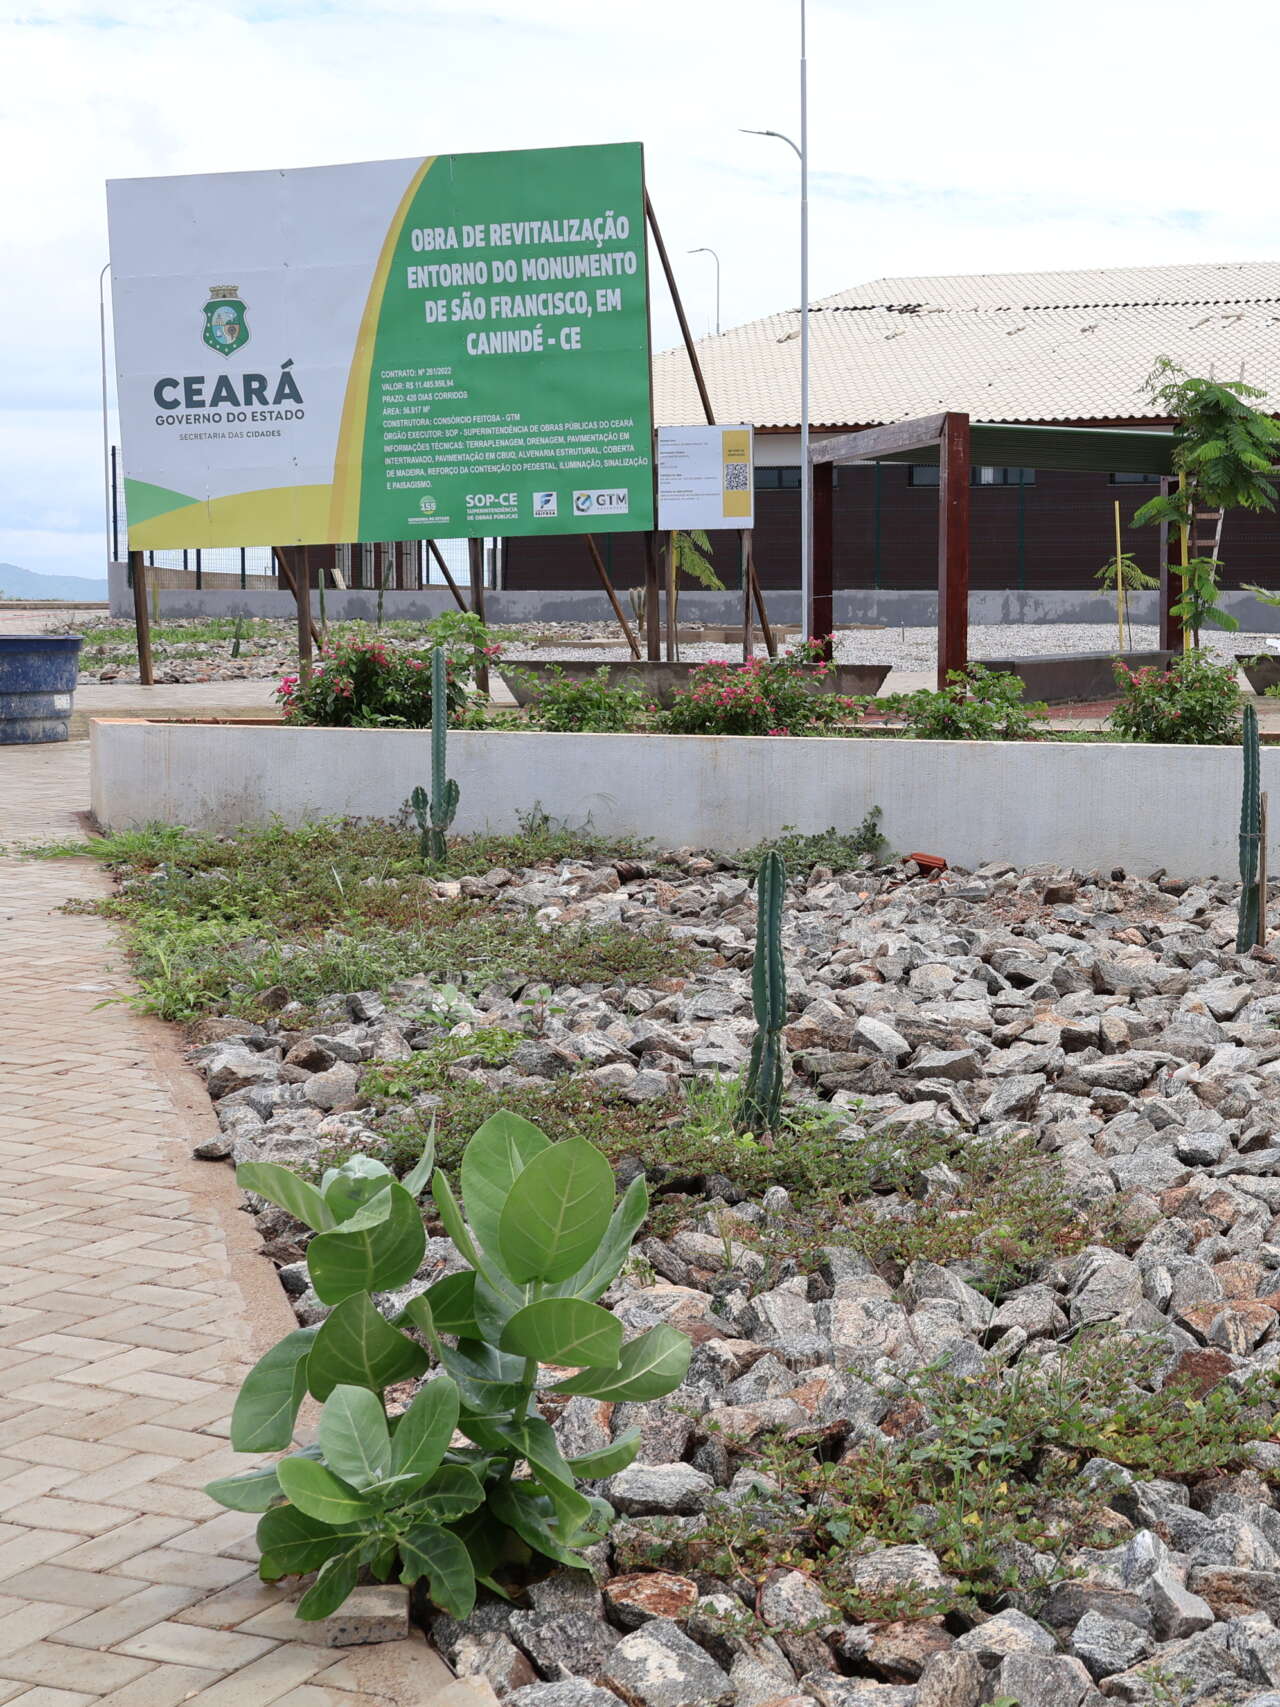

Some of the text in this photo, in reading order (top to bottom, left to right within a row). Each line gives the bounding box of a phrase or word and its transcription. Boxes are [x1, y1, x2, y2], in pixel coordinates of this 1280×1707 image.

[411, 210, 629, 252] OBRA DE REVITALIZAÇÃO
[407, 251, 637, 289] ENTORNO DO MONUMENTO
[425, 288, 622, 323] DE SÃO FRANCISCO, EM
[466, 324, 581, 355] CANINDÉ - CE
[154, 358, 304, 410] CEARÁ
[382, 382, 404, 391] VALOR:
[382, 394, 405, 403] PRAZO:
[418, 392, 433, 401] DIAS
[434, 391, 469, 400] CORRIDOS
[155, 409, 305, 426] GOVERNO DO ESTADO
[383, 418, 432, 428] CONSTRUTORA:
[433, 415, 472, 425] CONSÓRCIO
[473, 414, 501, 423] FEITOSA
[505, 413, 521, 422] GTM
[179, 432, 226, 441] SECRETARIA
[246, 430, 281, 438] CIDADES
[384, 430, 407, 440] ÓRGÃO
[407, 430, 445, 439] EXECUTOR:
[445, 429, 459, 437] SOP
[463, 424, 529, 436] SUPERINTENDÊNCIA
[529, 424, 539, 433] DE
[540, 422, 563, 431] OBRAS
[564, 420, 598, 430] PÚBLICAS
[610, 417, 634, 428] CEARÁ
[384, 442, 430, 453] INFORMAÇÕES
[567, 432, 617, 443] PAVIMENTAÇÃO
[619, 432, 630, 440] EM
[435, 451, 484, 462] PAVIMENTAÇÃO
[485, 452, 496, 460] EM
[519, 448, 555, 458] ALVENARIA
[603, 444, 635, 453] COBERTA
[387, 470, 395, 478] DE
[427, 466, 459, 476] REFORÇO
[460, 466, 469, 474] DA
[469, 462, 511, 474] CONTENÇÃO
[512, 464, 522, 472] DO
[604, 456, 648, 467] SINALIZAÇÃO
[465, 493, 518, 507] SOP-CE
[596, 493, 627, 506] GTM
